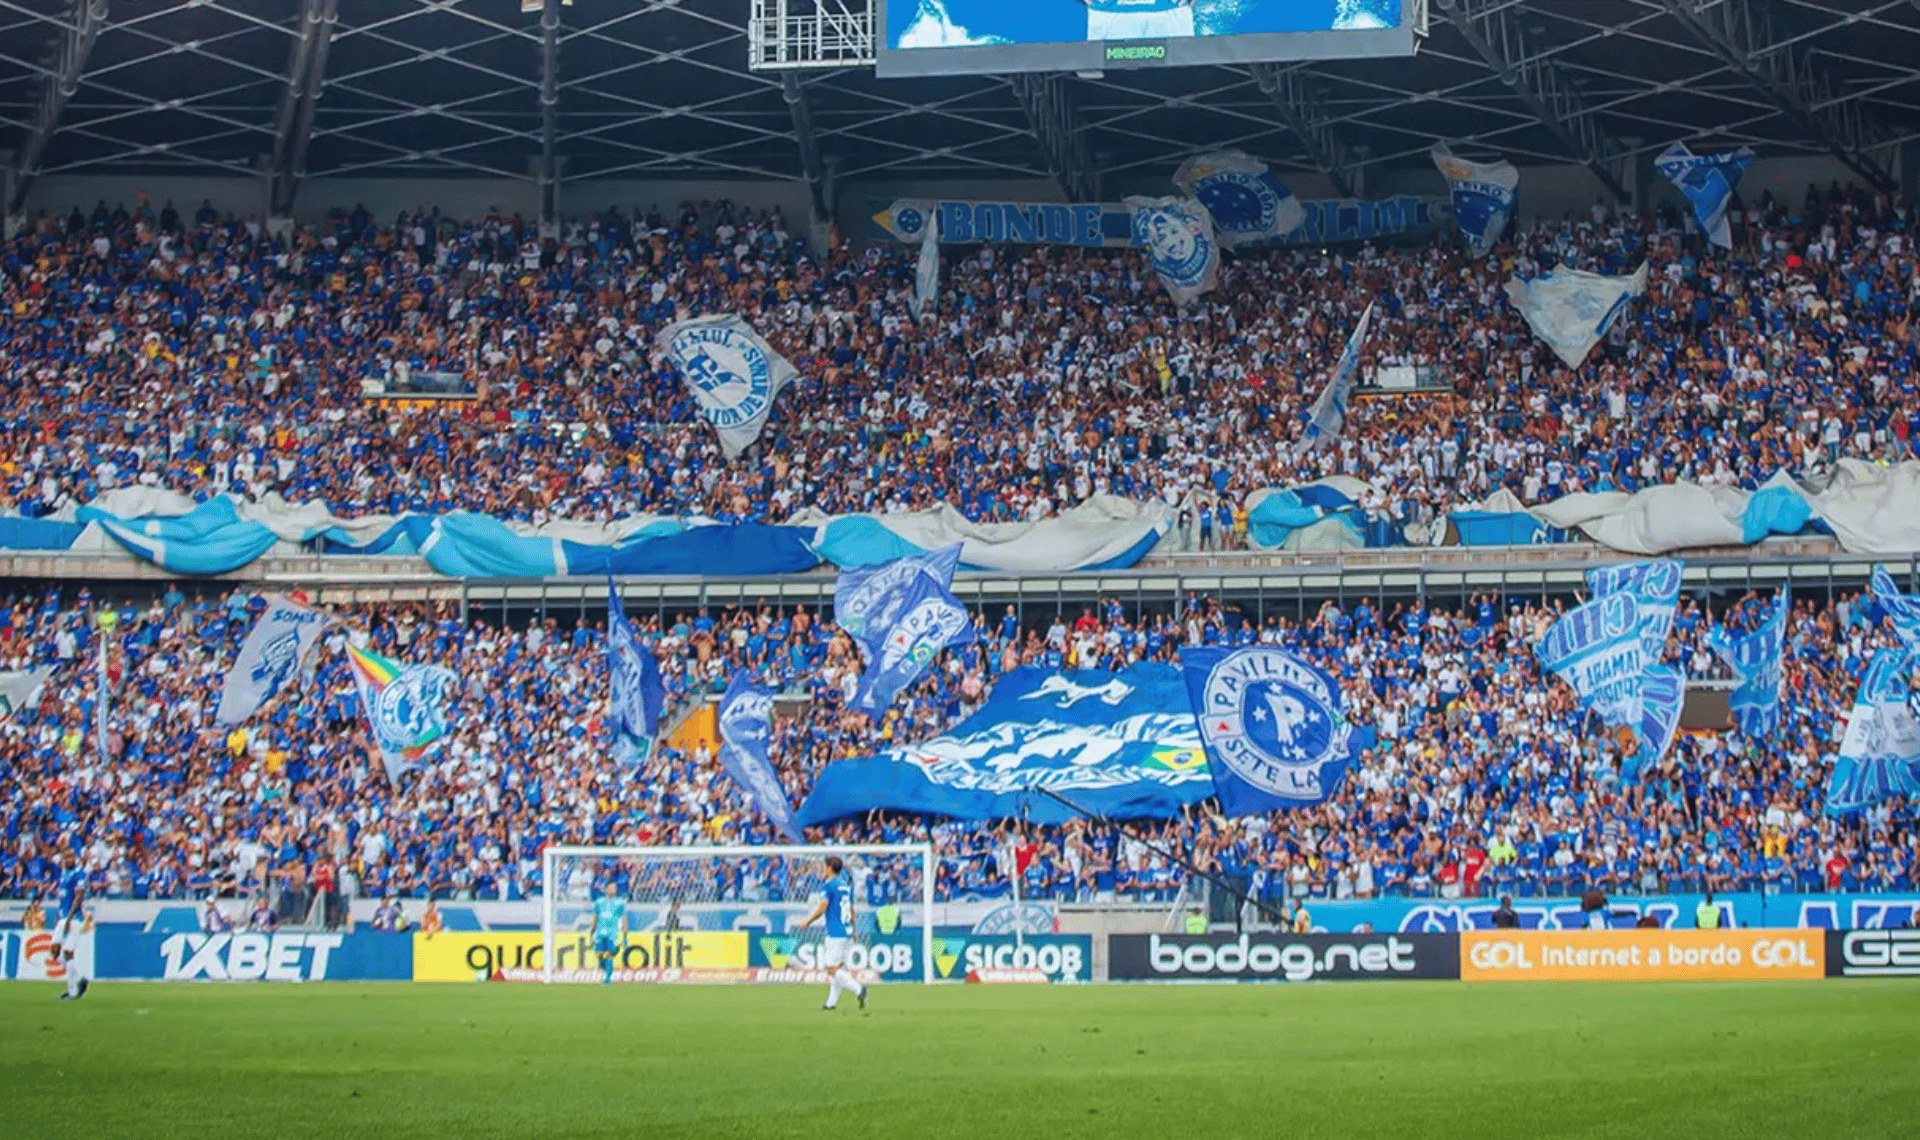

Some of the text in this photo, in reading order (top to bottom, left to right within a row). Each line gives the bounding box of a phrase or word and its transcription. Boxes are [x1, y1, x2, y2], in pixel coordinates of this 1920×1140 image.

[942, 201, 1104, 246] BONDE
[1225, 738, 1280, 784] SETE
[160, 932, 343, 980] 1XBET
[465, 933, 693, 981] quartolit
[797, 943, 913, 974] SIOOB
[964, 943, 1083, 974] SICOOB
[1150, 933, 1416, 981] bodog.net
[1469, 939, 1816, 969] GOL Internet a bordo GOL
